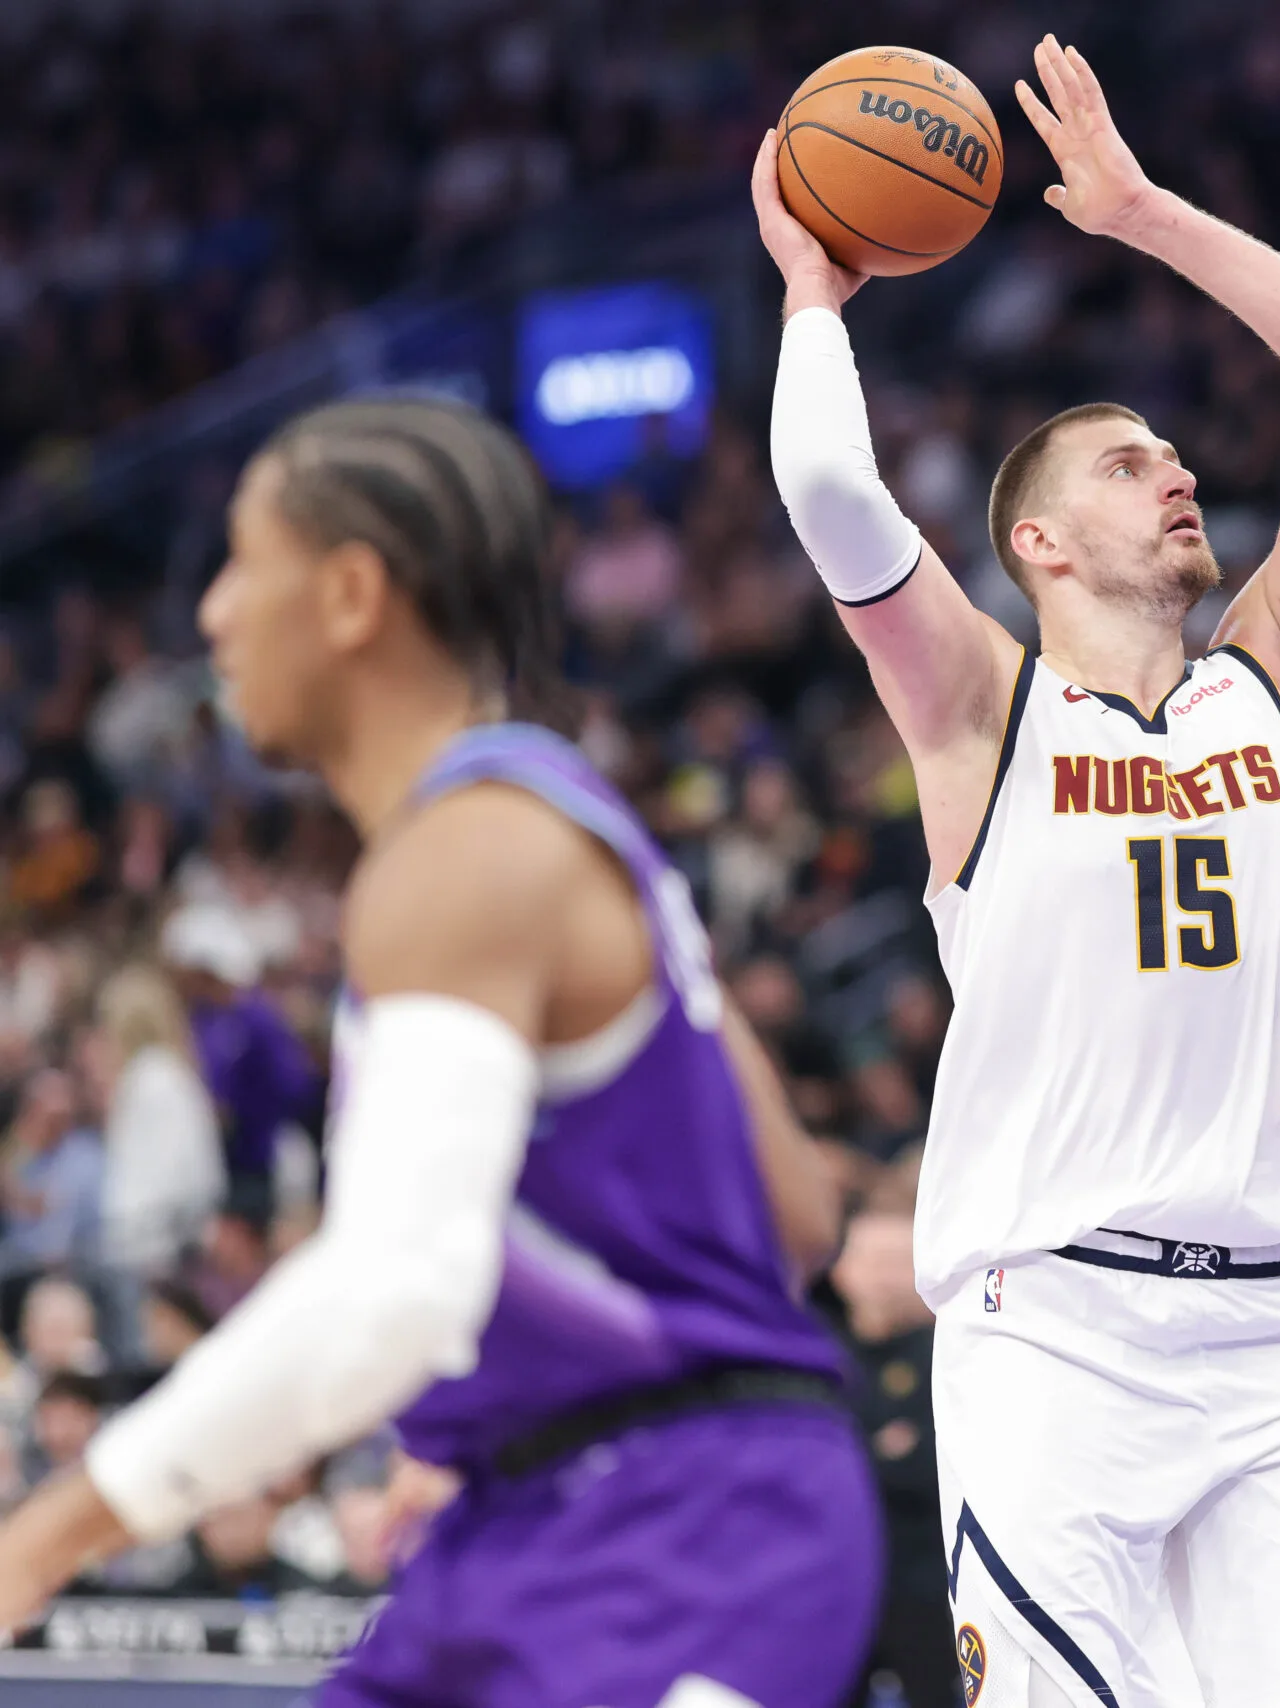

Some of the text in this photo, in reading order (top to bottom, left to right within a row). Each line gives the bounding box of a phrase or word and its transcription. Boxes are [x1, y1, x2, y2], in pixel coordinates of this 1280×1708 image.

[858, 89, 989, 187] Wilson
[1169, 678, 1234, 716] ibotta
[1126, 835, 1242, 973] 15
